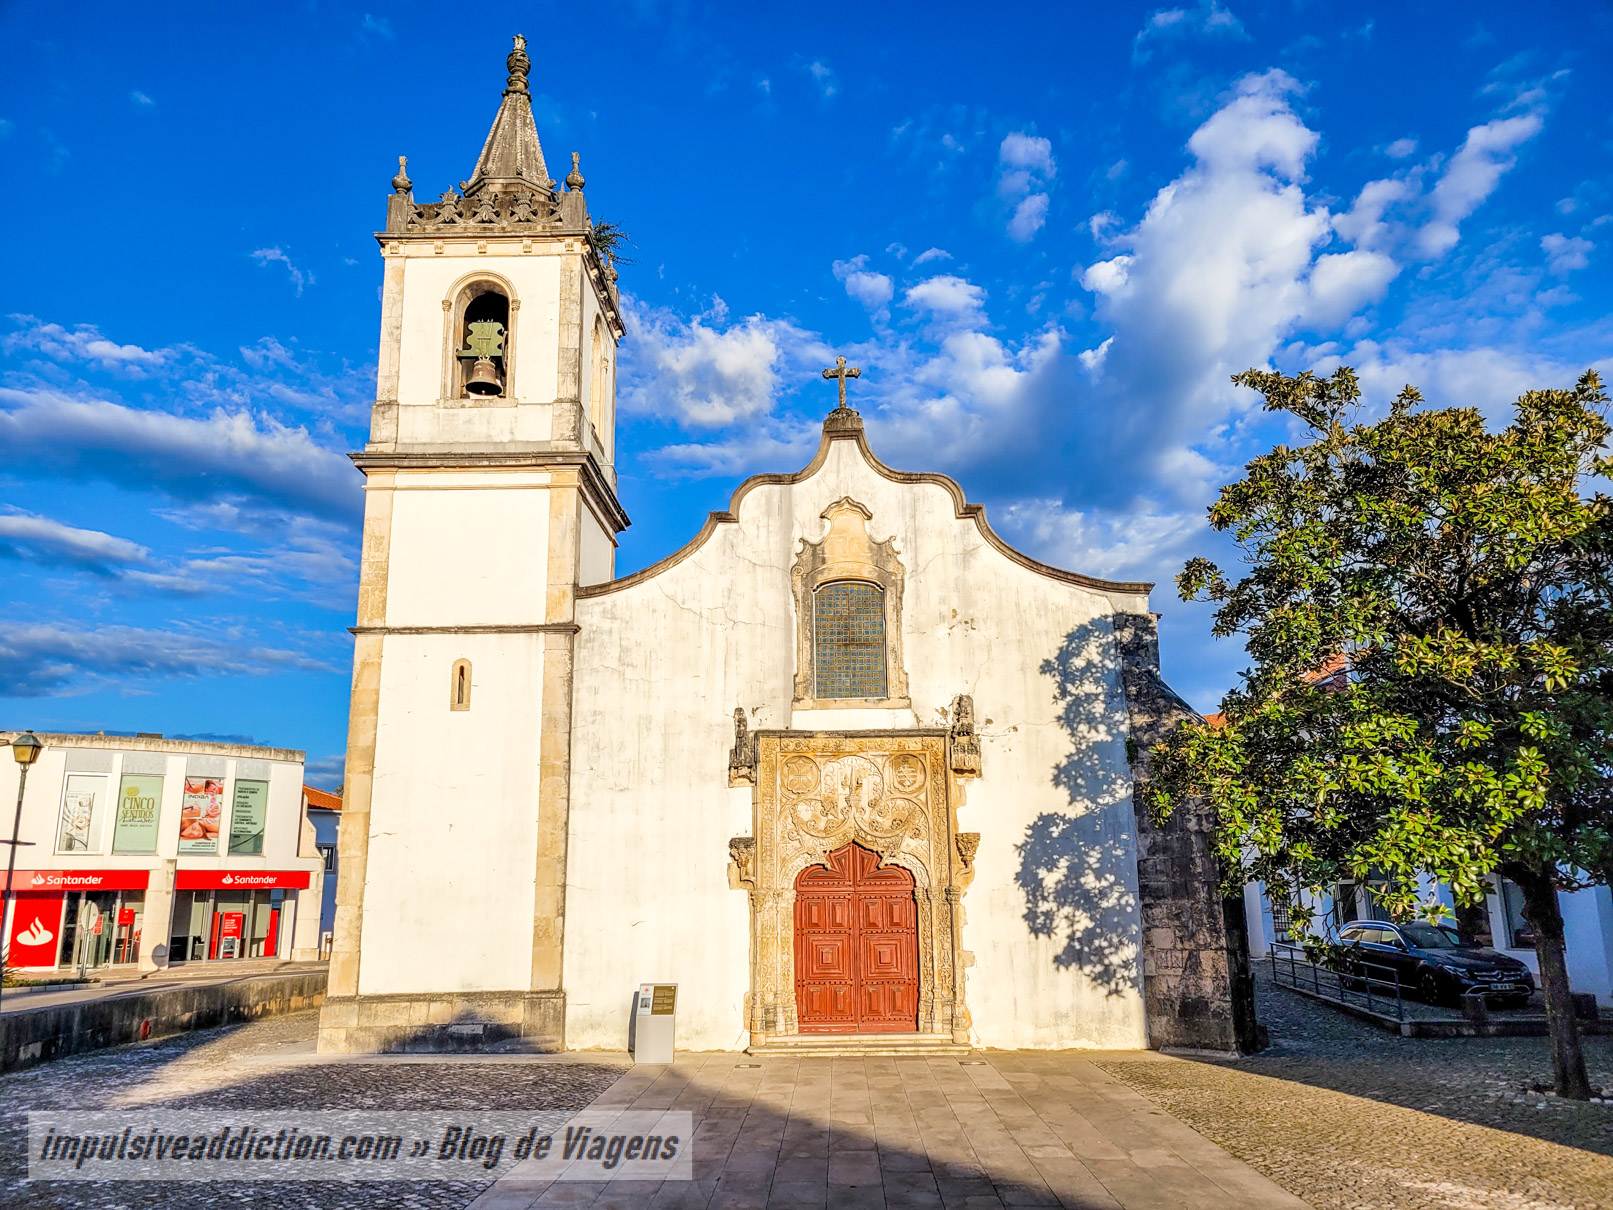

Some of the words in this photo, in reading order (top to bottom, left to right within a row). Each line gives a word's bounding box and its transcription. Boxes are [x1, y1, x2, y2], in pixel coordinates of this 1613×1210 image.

[123, 796, 155, 810] CINCO
[122, 809, 154, 819] SENTIDOS
[46, 875, 103, 885] Santander
[234, 875, 277, 884] Santander
